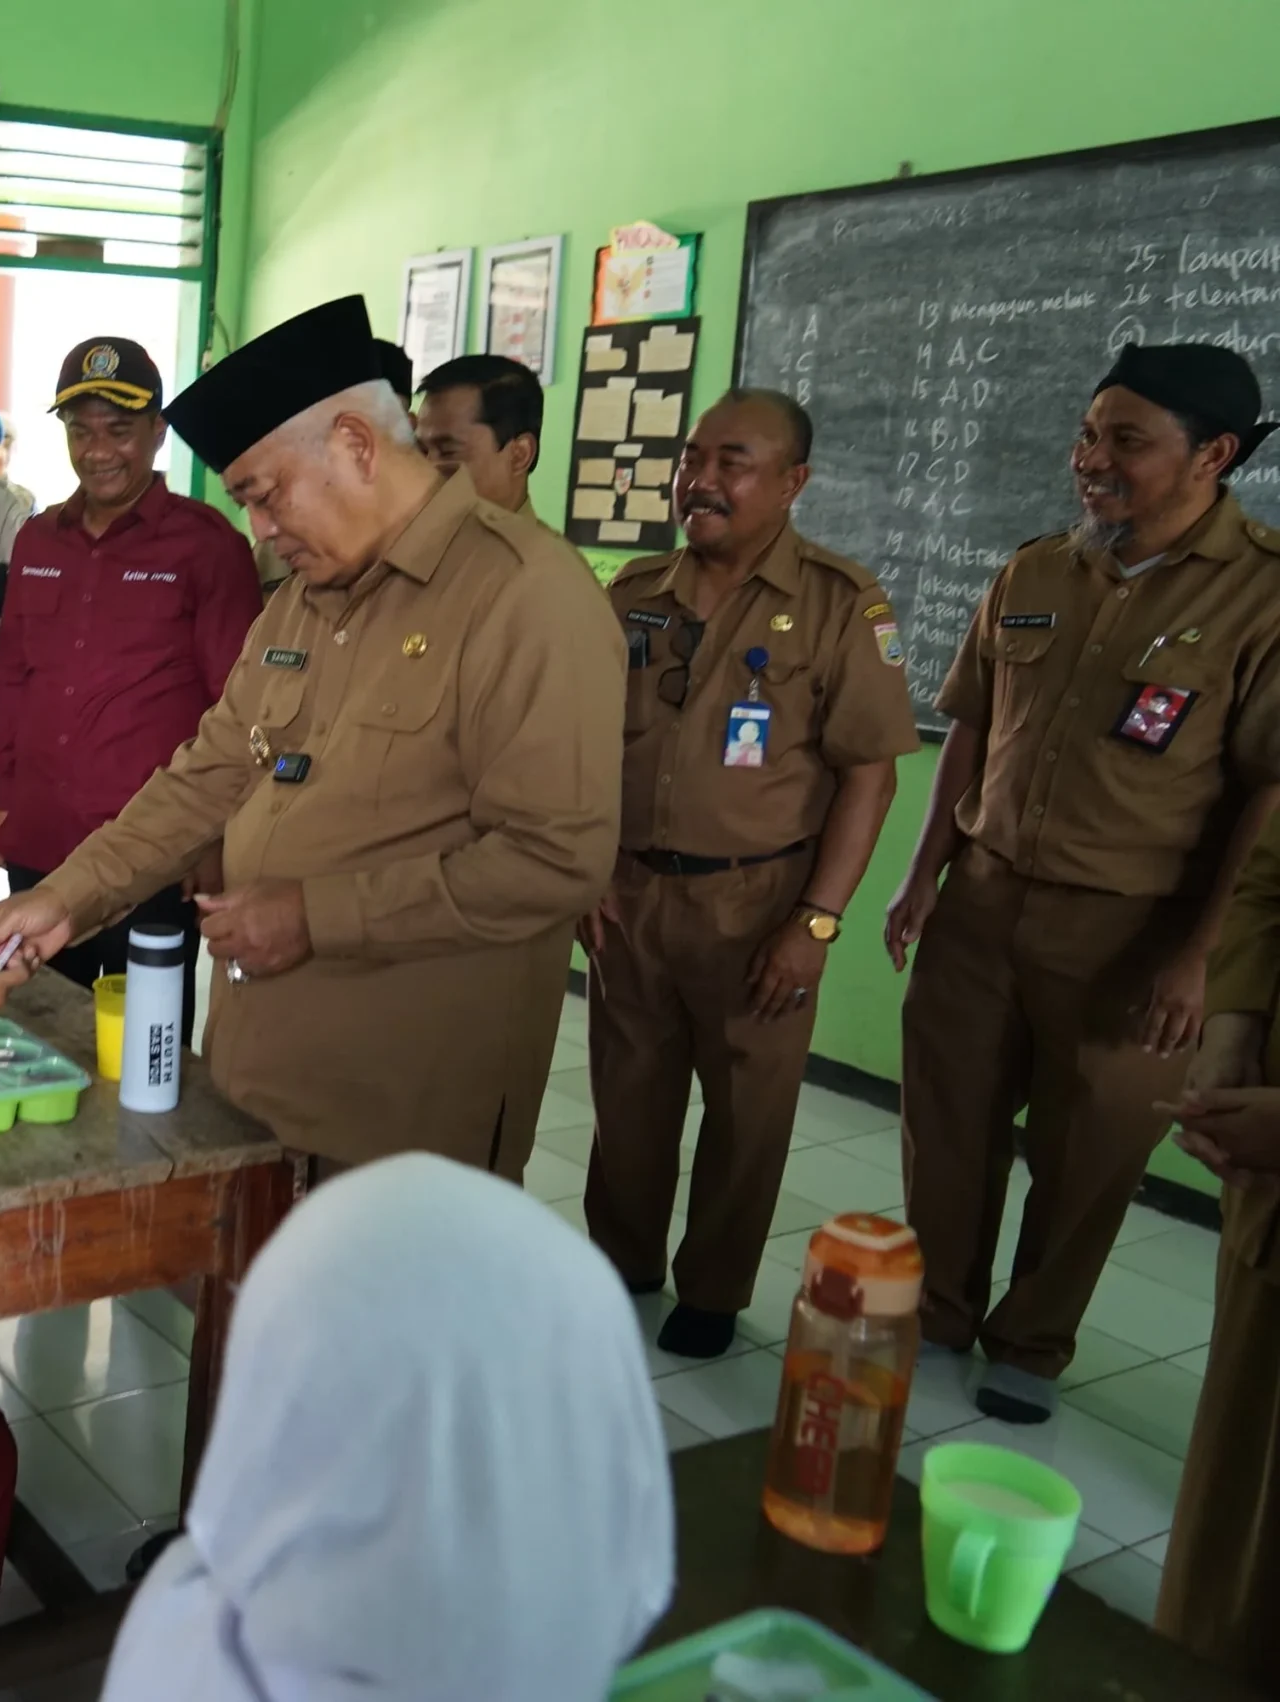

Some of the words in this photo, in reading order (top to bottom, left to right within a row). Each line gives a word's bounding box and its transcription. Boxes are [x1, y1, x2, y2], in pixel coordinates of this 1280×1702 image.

[802, 313, 818, 342] A
[919, 300, 939, 331] 13
[795, 350, 814, 372] C
[797, 378, 811, 406] B
[897, 451, 920, 478] 17
[885, 528, 904, 556] 19
[163, 1020, 174, 1083] YOUTH
